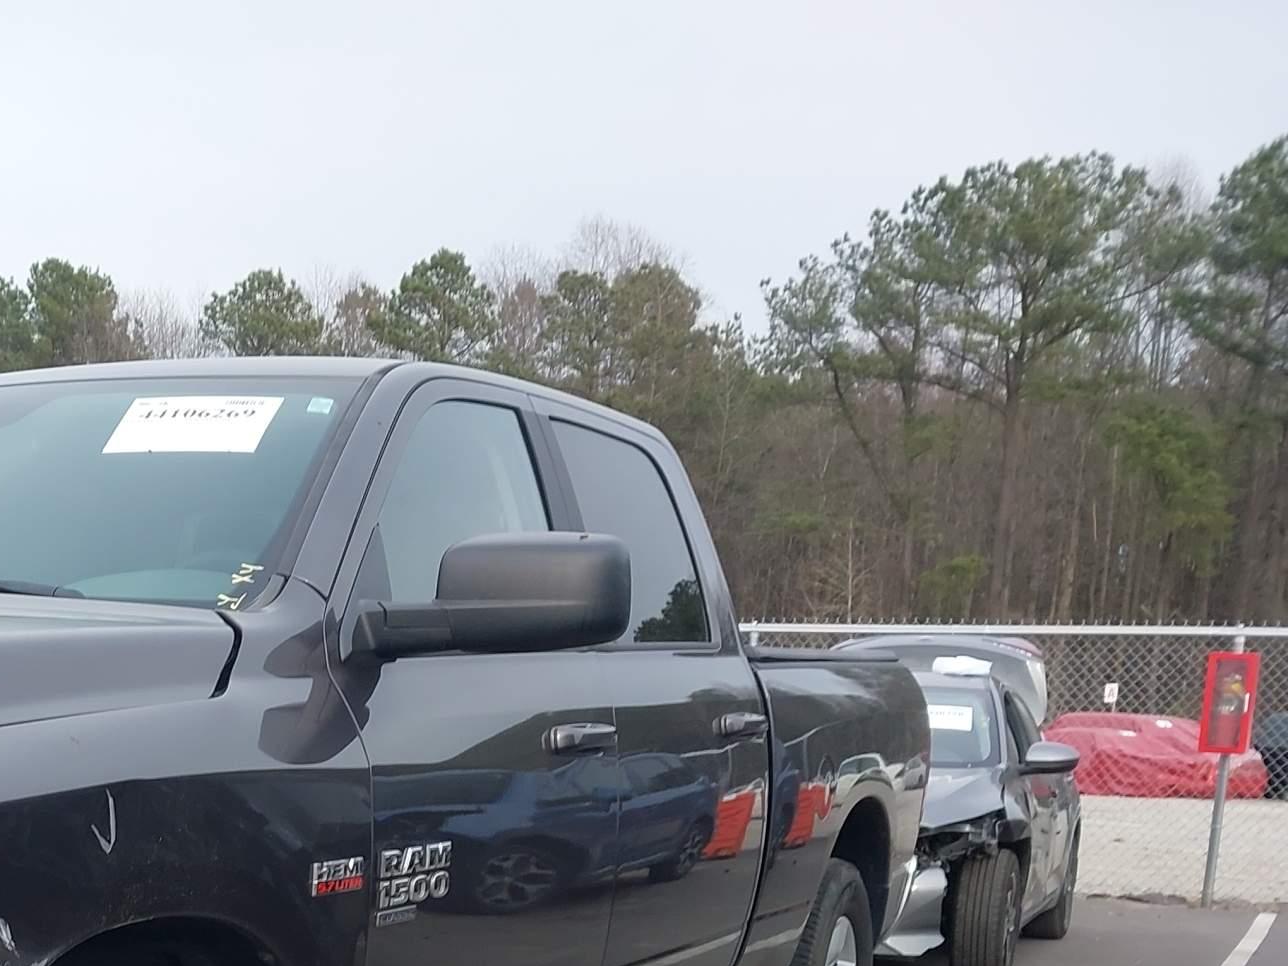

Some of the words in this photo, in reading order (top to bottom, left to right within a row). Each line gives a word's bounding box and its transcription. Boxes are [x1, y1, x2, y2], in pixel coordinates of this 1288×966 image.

[138, 407, 256, 419] 44106269
[380, 841, 452, 879] RAM
[317, 881, 335, 895] 5.7
[378, 870, 450, 910] 1500
